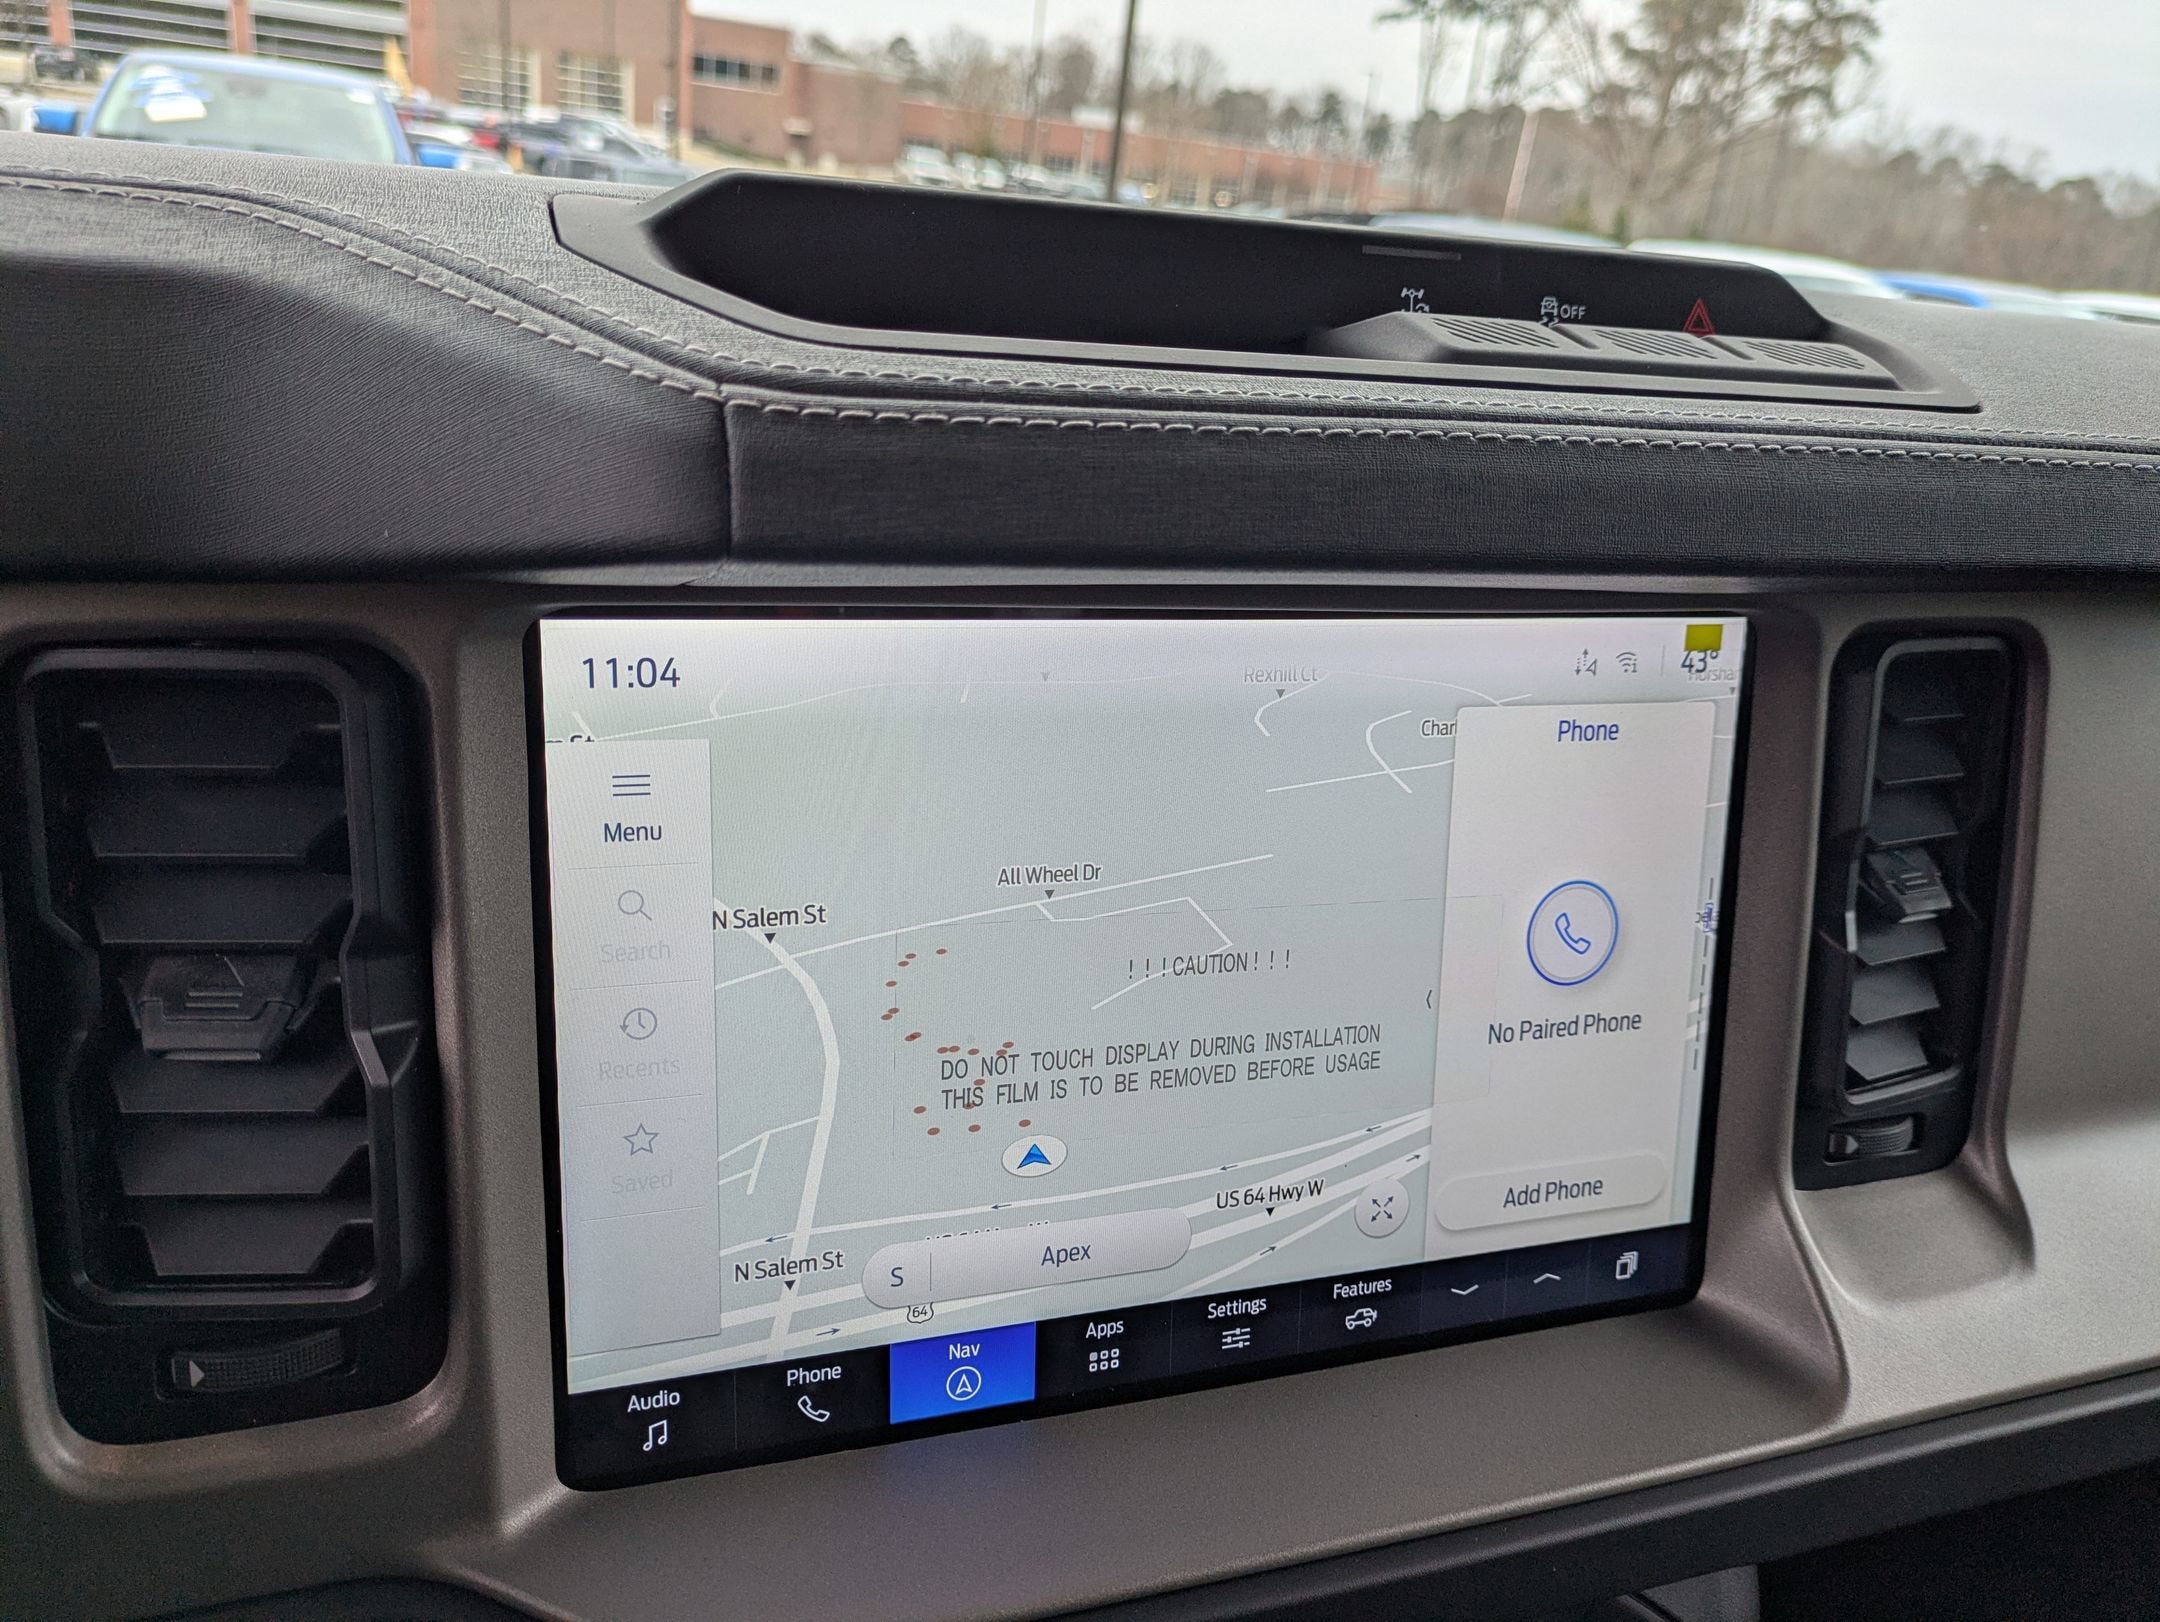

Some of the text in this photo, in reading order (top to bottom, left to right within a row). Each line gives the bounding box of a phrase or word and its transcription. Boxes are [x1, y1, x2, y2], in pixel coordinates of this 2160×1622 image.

[1560, 304, 1586, 319] OFF
[582, 657, 680, 688] 11:04
[1244, 666, 1318, 683] Rexhill Ct
[1557, 719, 1619, 742] Phone
[603, 822, 662, 843] Menu
[998, 864, 1101, 886] All Wheel Dr
[712, 905, 827, 930] N Salem St
[600, 940, 671, 963] Search
[1488, 1013, 1642, 1044] No Paired Phone
[941, 1024, 1381, 1080] DO NOT TOUCH DISPLAY DURING INSTALLATION
[600, 1057, 680, 1080] Recents
[941, 1051, 1381, 1110] THIS FILM IS TO BE REMOVED BEFORE USAGE
[612, 1170, 673, 1194] Saved
[1503, 1179, 1604, 1208] Add Phone
[1217, 1179, 1325, 1210] US 64 Hwy W
[734, 1251, 844, 1282] N Salem St
[1041, 1245, 1092, 1267] Apex
[890, 1267, 904, 1288] S
[1333, 1278, 1392, 1299] Features
[911, 1306, 928, 1319] 64
[1207, 1297, 1267, 1321] Settings
[1086, 1320, 1125, 1339] Apps
[948, 1342, 980, 1361] Nav
[786, 1363, 843, 1388] Phone
[627, 1389, 681, 1414] Audio
